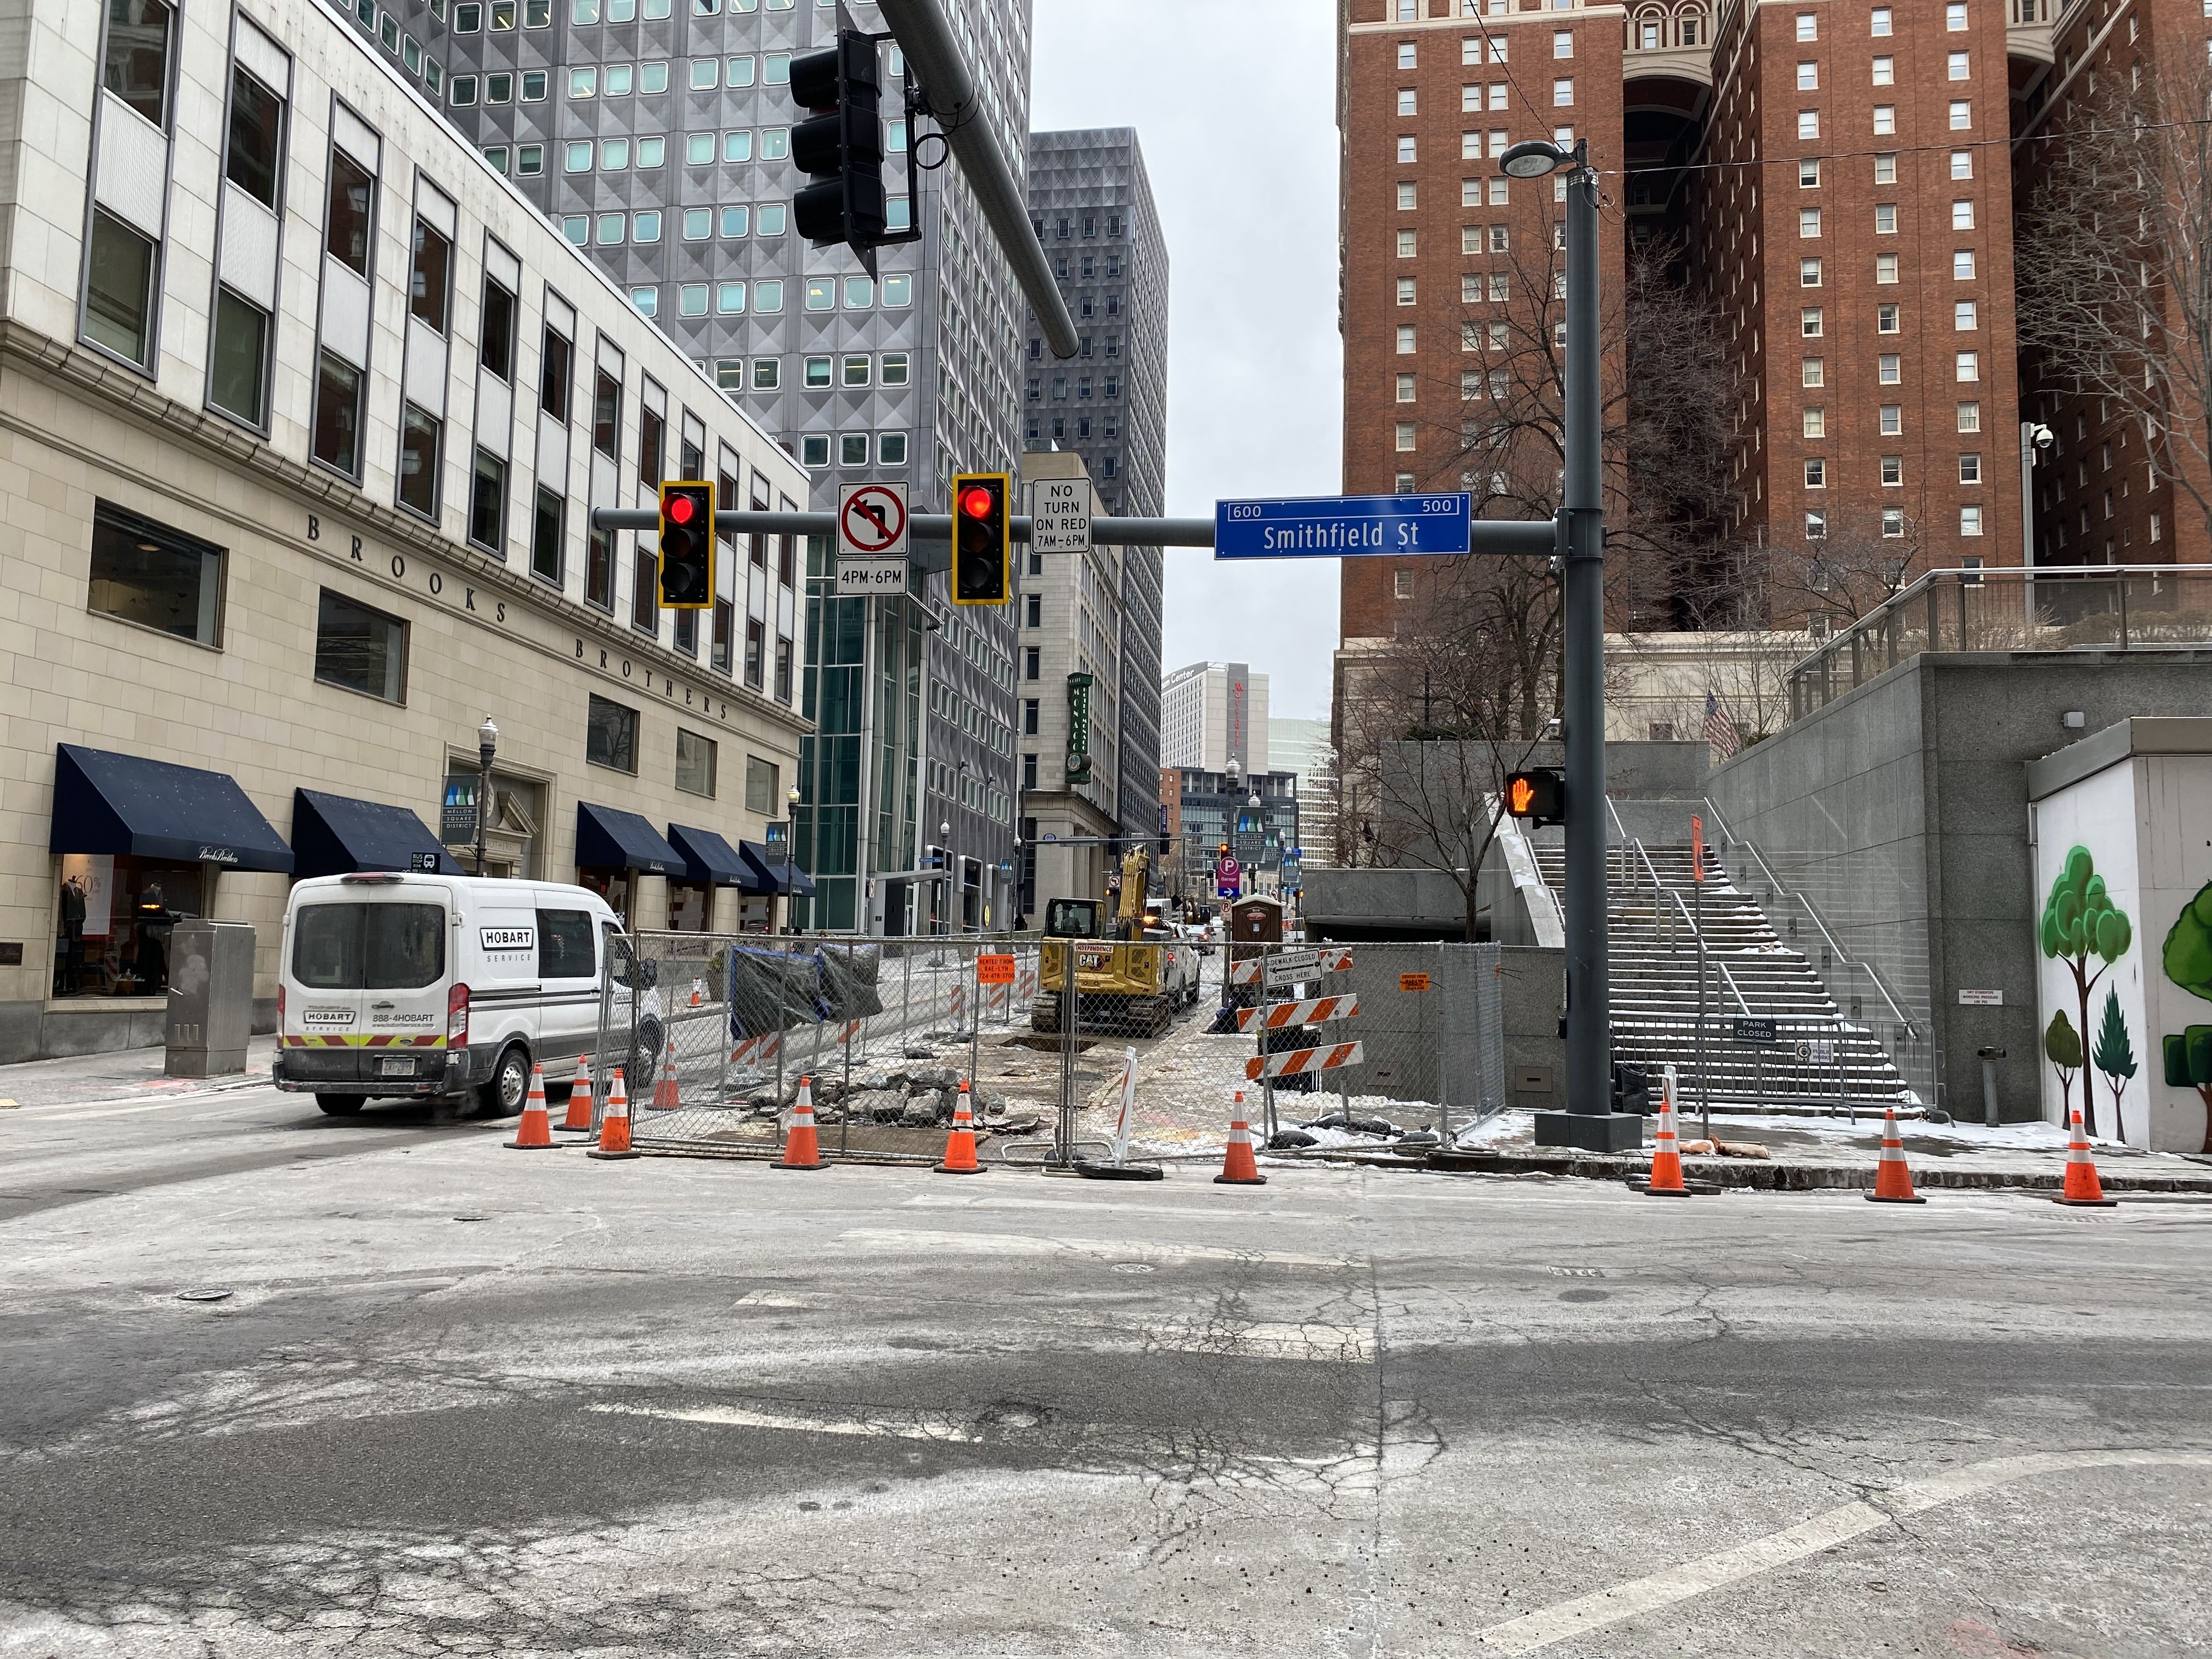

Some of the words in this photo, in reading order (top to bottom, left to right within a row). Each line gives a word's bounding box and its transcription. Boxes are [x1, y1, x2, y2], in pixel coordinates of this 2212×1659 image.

[1050, 485, 1073, 496] NO
[1045, 501, 1080, 513] TURN
[1233, 506, 1261, 518] 600
[1422, 500, 1452, 512] 500
[1036, 518, 1053, 531] ON
[1061, 518, 1086, 530] RED
[1263, 522, 1383, 549] Smithfield
[1398, 523, 1419, 546] St
[842, 569, 902, 584] 4PM-6PM
[307, 514, 505, 623] BROOKS
[575, 639, 726, 719] BROTHERS
[1171, 670, 1194, 684] Center
[1233, 682, 1243, 747] Marriott
[199, 846, 217, 860] Brooks
[217, 848, 238, 863] Brothers
[486, 932, 529, 943] HOBART
[1079, 954, 1099, 967] CAT
[1294, 953, 1316, 963] CLOSED
[1275, 974, 1293, 982] CROSS
